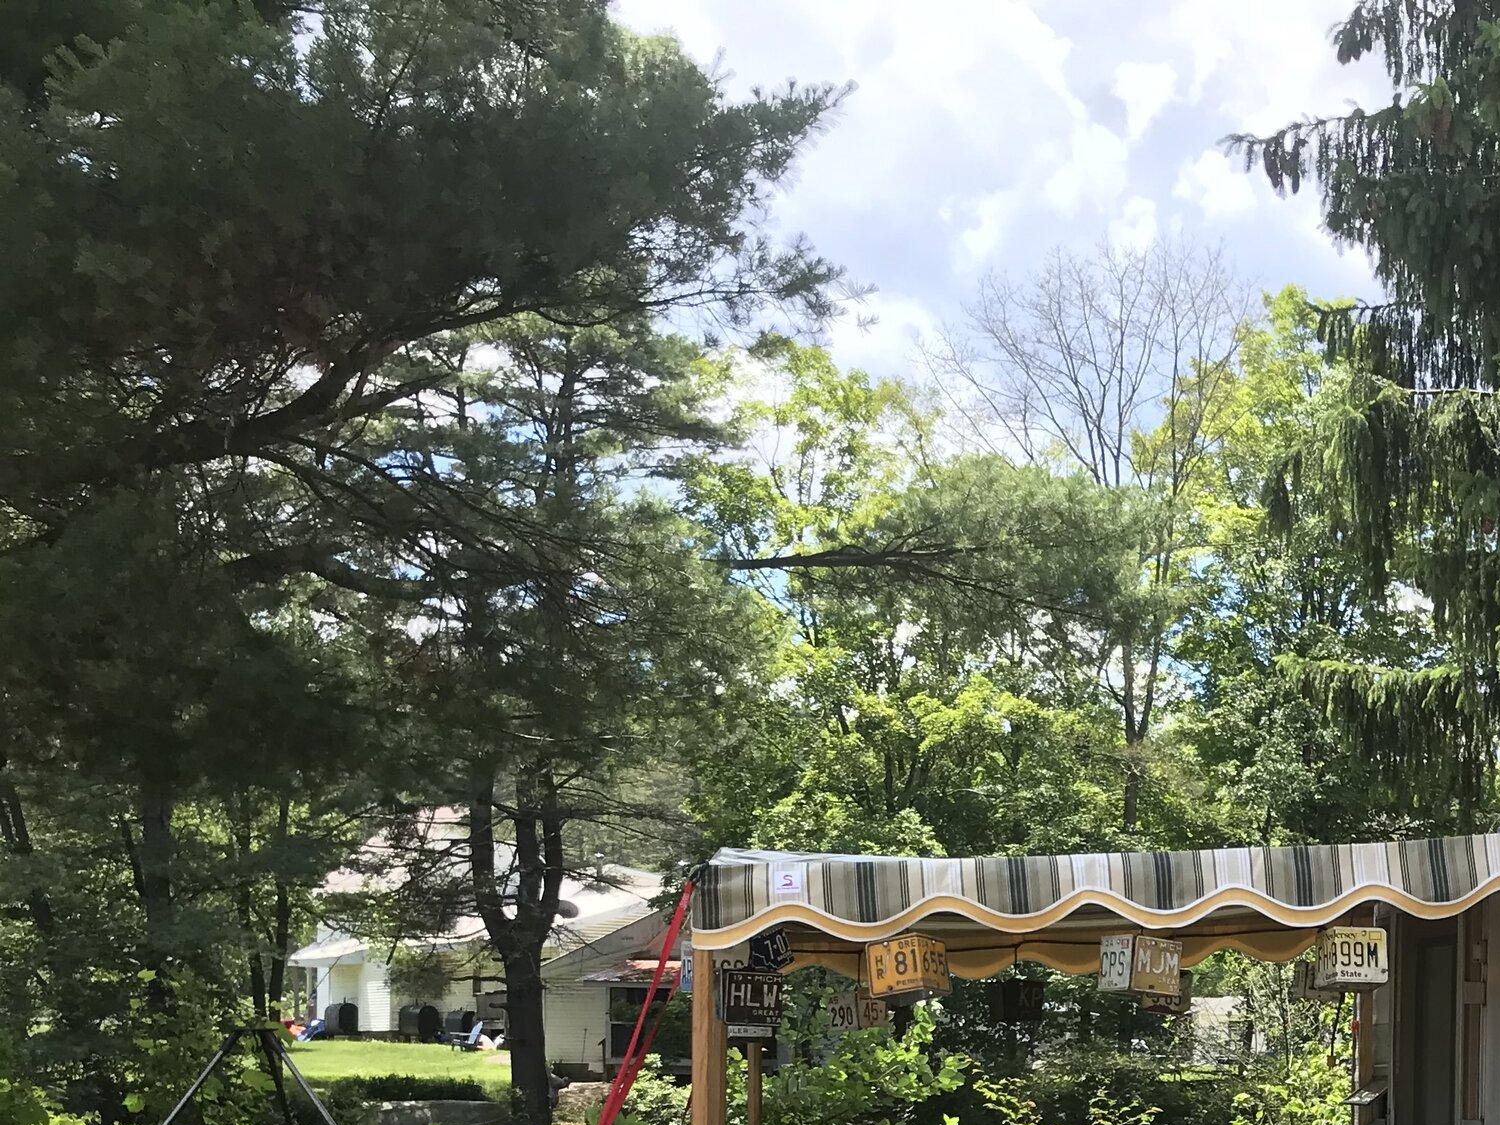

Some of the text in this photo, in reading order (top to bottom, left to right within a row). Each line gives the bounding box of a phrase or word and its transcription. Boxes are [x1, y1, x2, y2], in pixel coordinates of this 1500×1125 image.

[1101, 950, 1126, 978] CPS
[1137, 947, 1179, 976] MJM
[1340, 969, 1362, 978] State
[730, 983, 778, 1008] HLW
